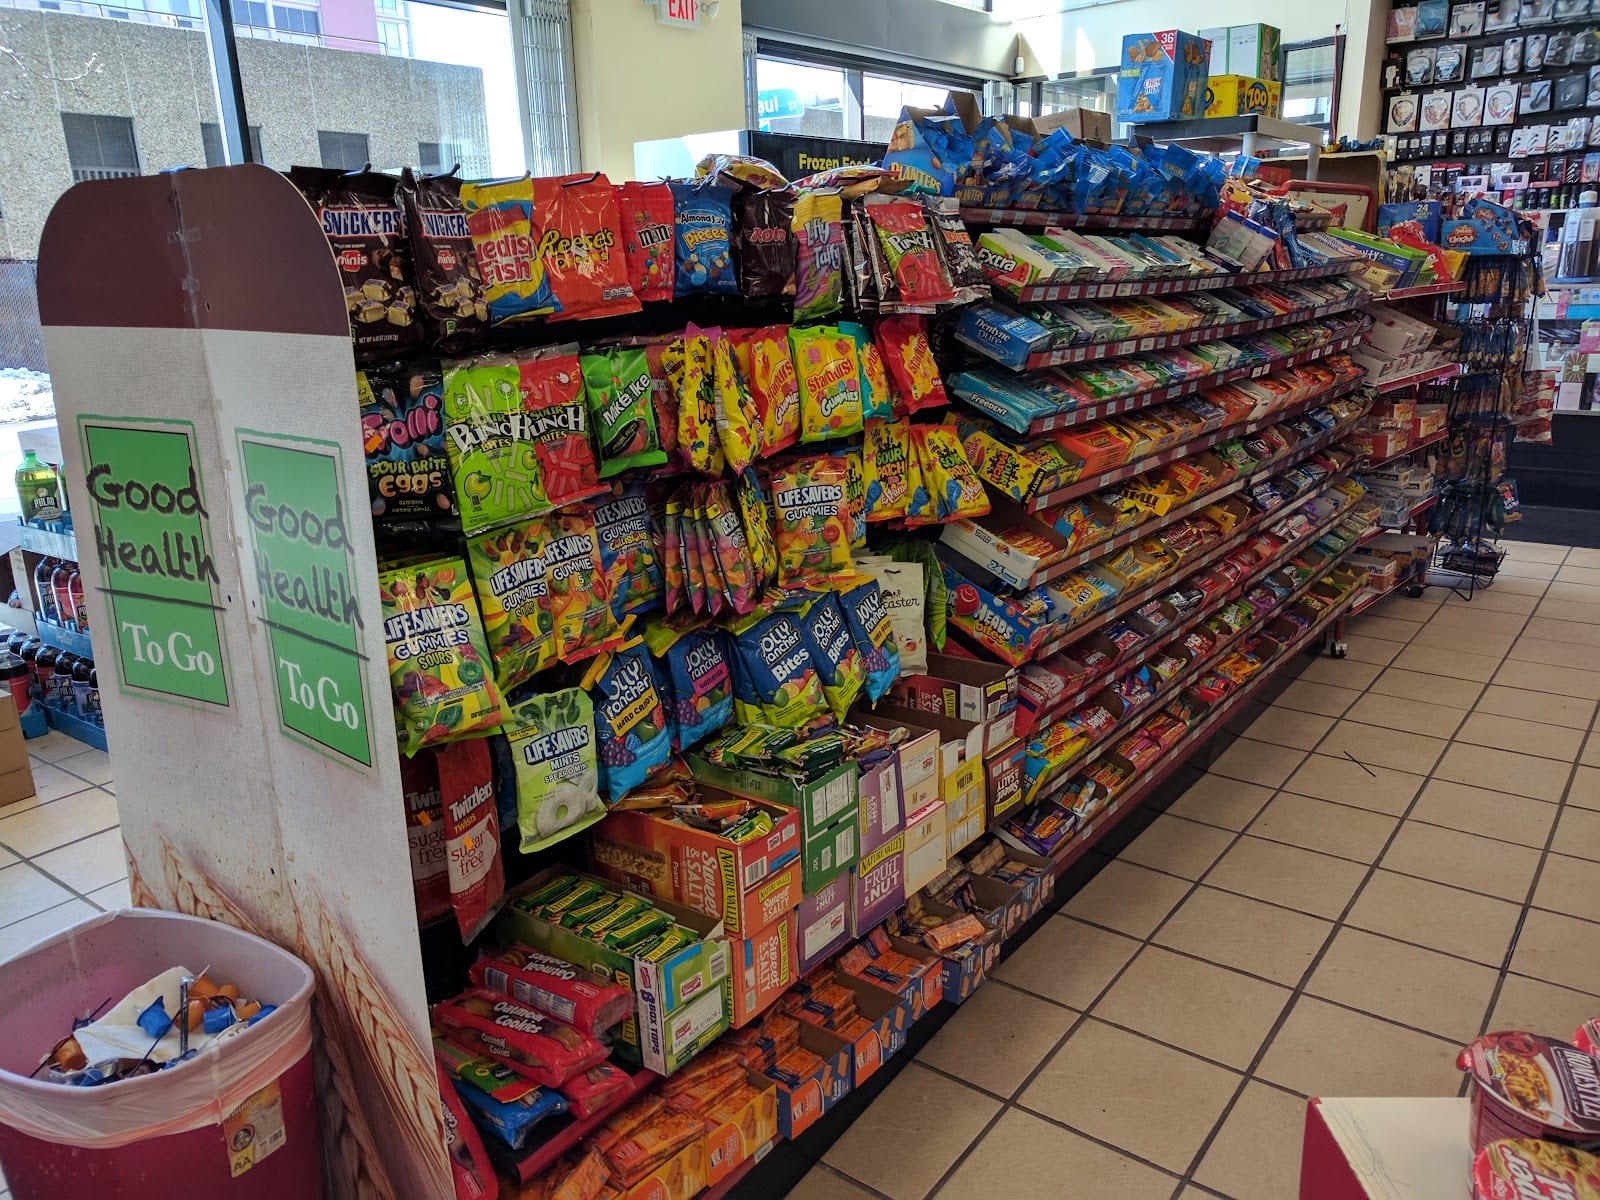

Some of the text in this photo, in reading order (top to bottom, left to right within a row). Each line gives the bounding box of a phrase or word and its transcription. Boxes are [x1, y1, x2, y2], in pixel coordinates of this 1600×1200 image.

[1161, 33, 1175, 44] 36
[1247, 88, 1267, 107] ZOO
[799, 154, 839, 170] Frozen
[890, 162, 941, 191] PLANTERS
[322, 209, 401, 236] SNICKERS
[681, 213, 711, 225] Almond
[539, 229, 614, 259] Reese's
[888, 230, 934, 250] PUNCH
[337, 254, 368, 268] minis
[813, 243, 842, 269] Taffy
[480, 257, 532, 286] Fish
[975, 318, 1011, 347] Dentyne pure
[806, 358, 855, 393] Starburst
[527, 404, 586, 436] UNCH
[540, 430, 568, 443] BITES
[370, 459, 409, 478] SOUR
[877, 448, 906, 480] SOUR PATCH
[34, 496, 56, 509] POLAR
[86, 463, 209, 519] Good
[245, 483, 354, 556] Good
[785, 505, 839, 522] GUMMIES
[94, 524, 220, 584] Health
[552, 558, 594, 581] GUMMIE
[252, 549, 364, 630] Health
[501, 582, 547, 613] GUMMIES
[811, 606, 834, 643] JOLLY
[827, 629, 850, 665] Bites
[973, 602, 1014, 641] NERDS
[973, 619, 1006, 646] bites
[122, 621, 215, 676] To Go
[394, 630, 470, 660] GUMMIES
[686, 638, 725, 681] JOLLY rancher
[759, 620, 810, 683] JOLLY rancher Bites
[417, 650, 454, 671] SOURS
[280, 657, 360, 731] To Go
[605, 678, 652, 721] rancher
[616, 711, 634, 731] HARD
[550, 751, 581, 772] MINTS
[448, 781, 494, 822] Twizzlers
[454, 814, 477, 835] TWISTS
[409, 830, 447, 850] suga
[457, 850, 485, 877] free
[860, 835, 904, 878] NATURE VALLEY
[701, 851, 721, 920] Sweet
[864, 855, 898, 893] FRUIT
[869, 871, 899, 904] NUT
[718, 847, 738, 932] NATURE VALLEY
[762, 888, 789, 910] Sweet
[768, 900, 790, 919] SALTY
[525, 962, 576, 980] Oatmeal
[493, 1000, 547, 1035] Oatmeal Cookies
[651, 1026, 659, 1056] TOPS
